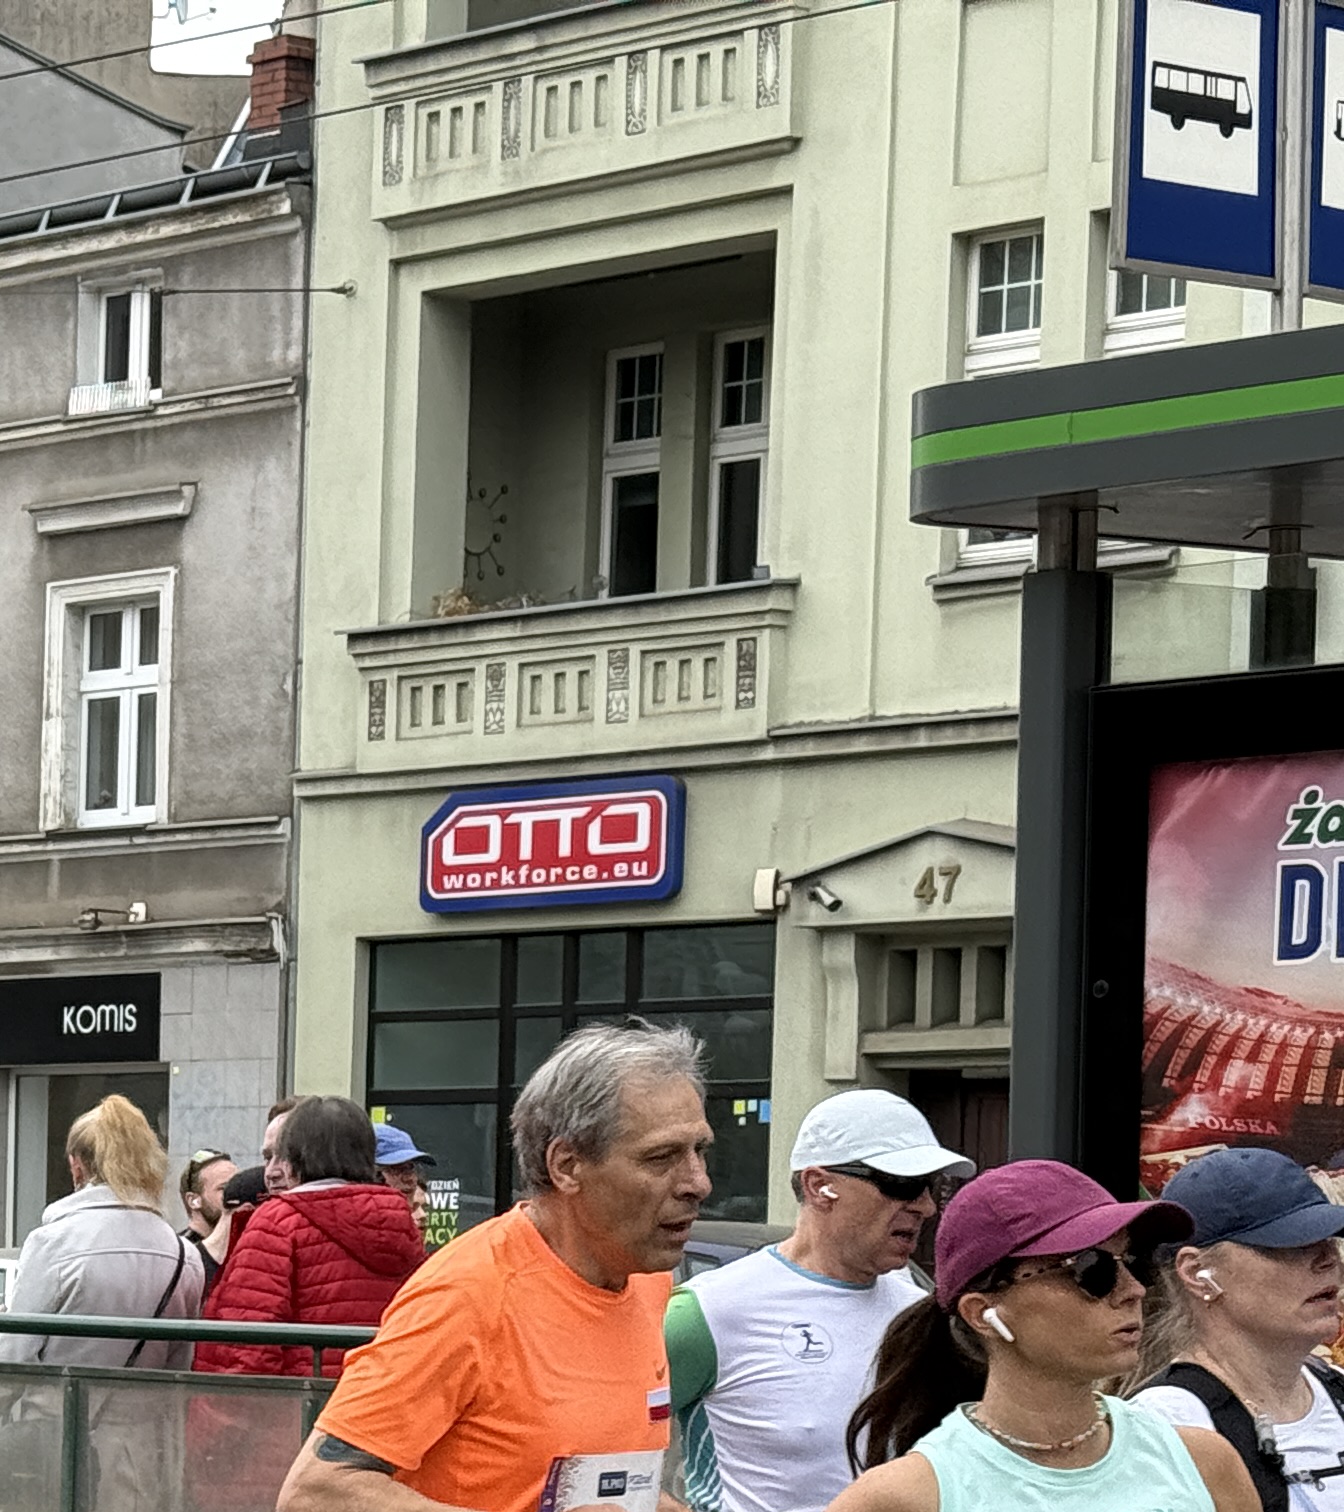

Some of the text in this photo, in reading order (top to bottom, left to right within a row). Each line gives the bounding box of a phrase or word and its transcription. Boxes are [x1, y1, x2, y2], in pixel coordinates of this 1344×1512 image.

[441, 802, 652, 866] OTTO
[442, 861, 649, 891] workforce.eu
[914, 864, 963, 905] 47
[62, 1003, 138, 1035] KOMIS
